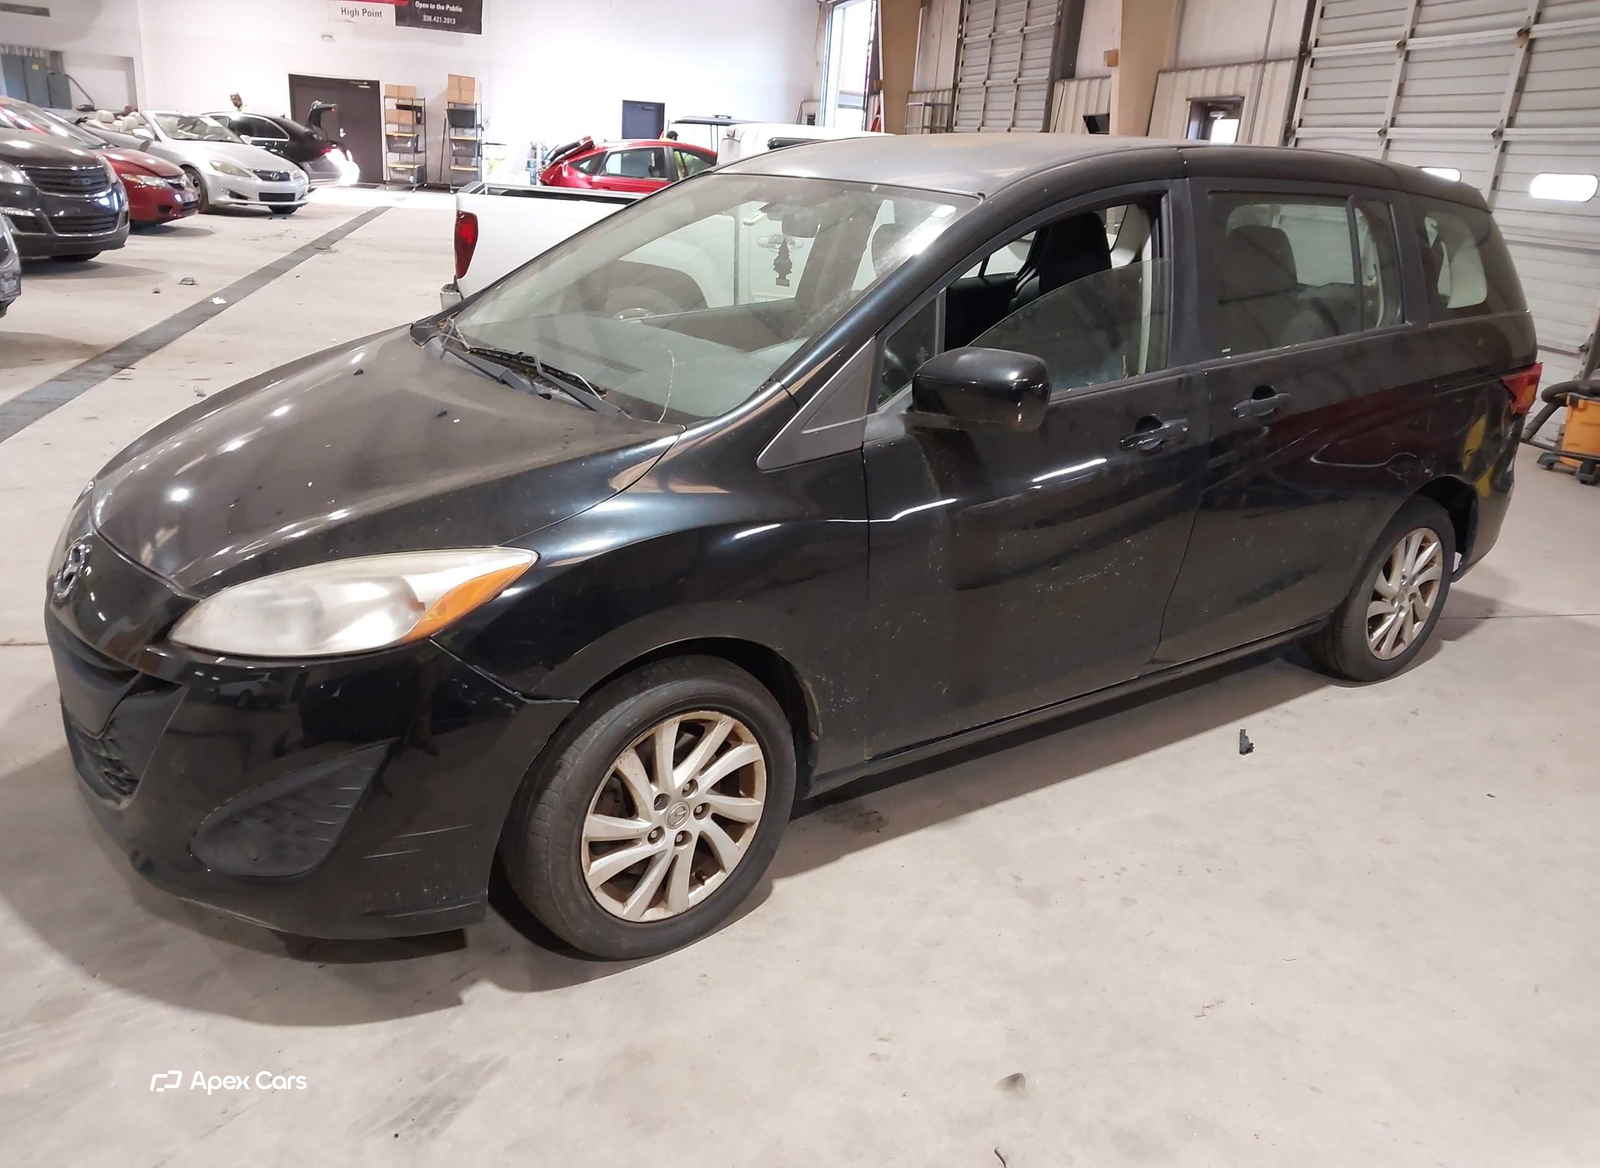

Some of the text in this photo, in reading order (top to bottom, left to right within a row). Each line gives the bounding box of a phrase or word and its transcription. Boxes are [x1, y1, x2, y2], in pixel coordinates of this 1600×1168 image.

[415, 1, 429, 9] Open
[446, 4, 463, 12] Public
[341, 7, 382, 18] High Point
